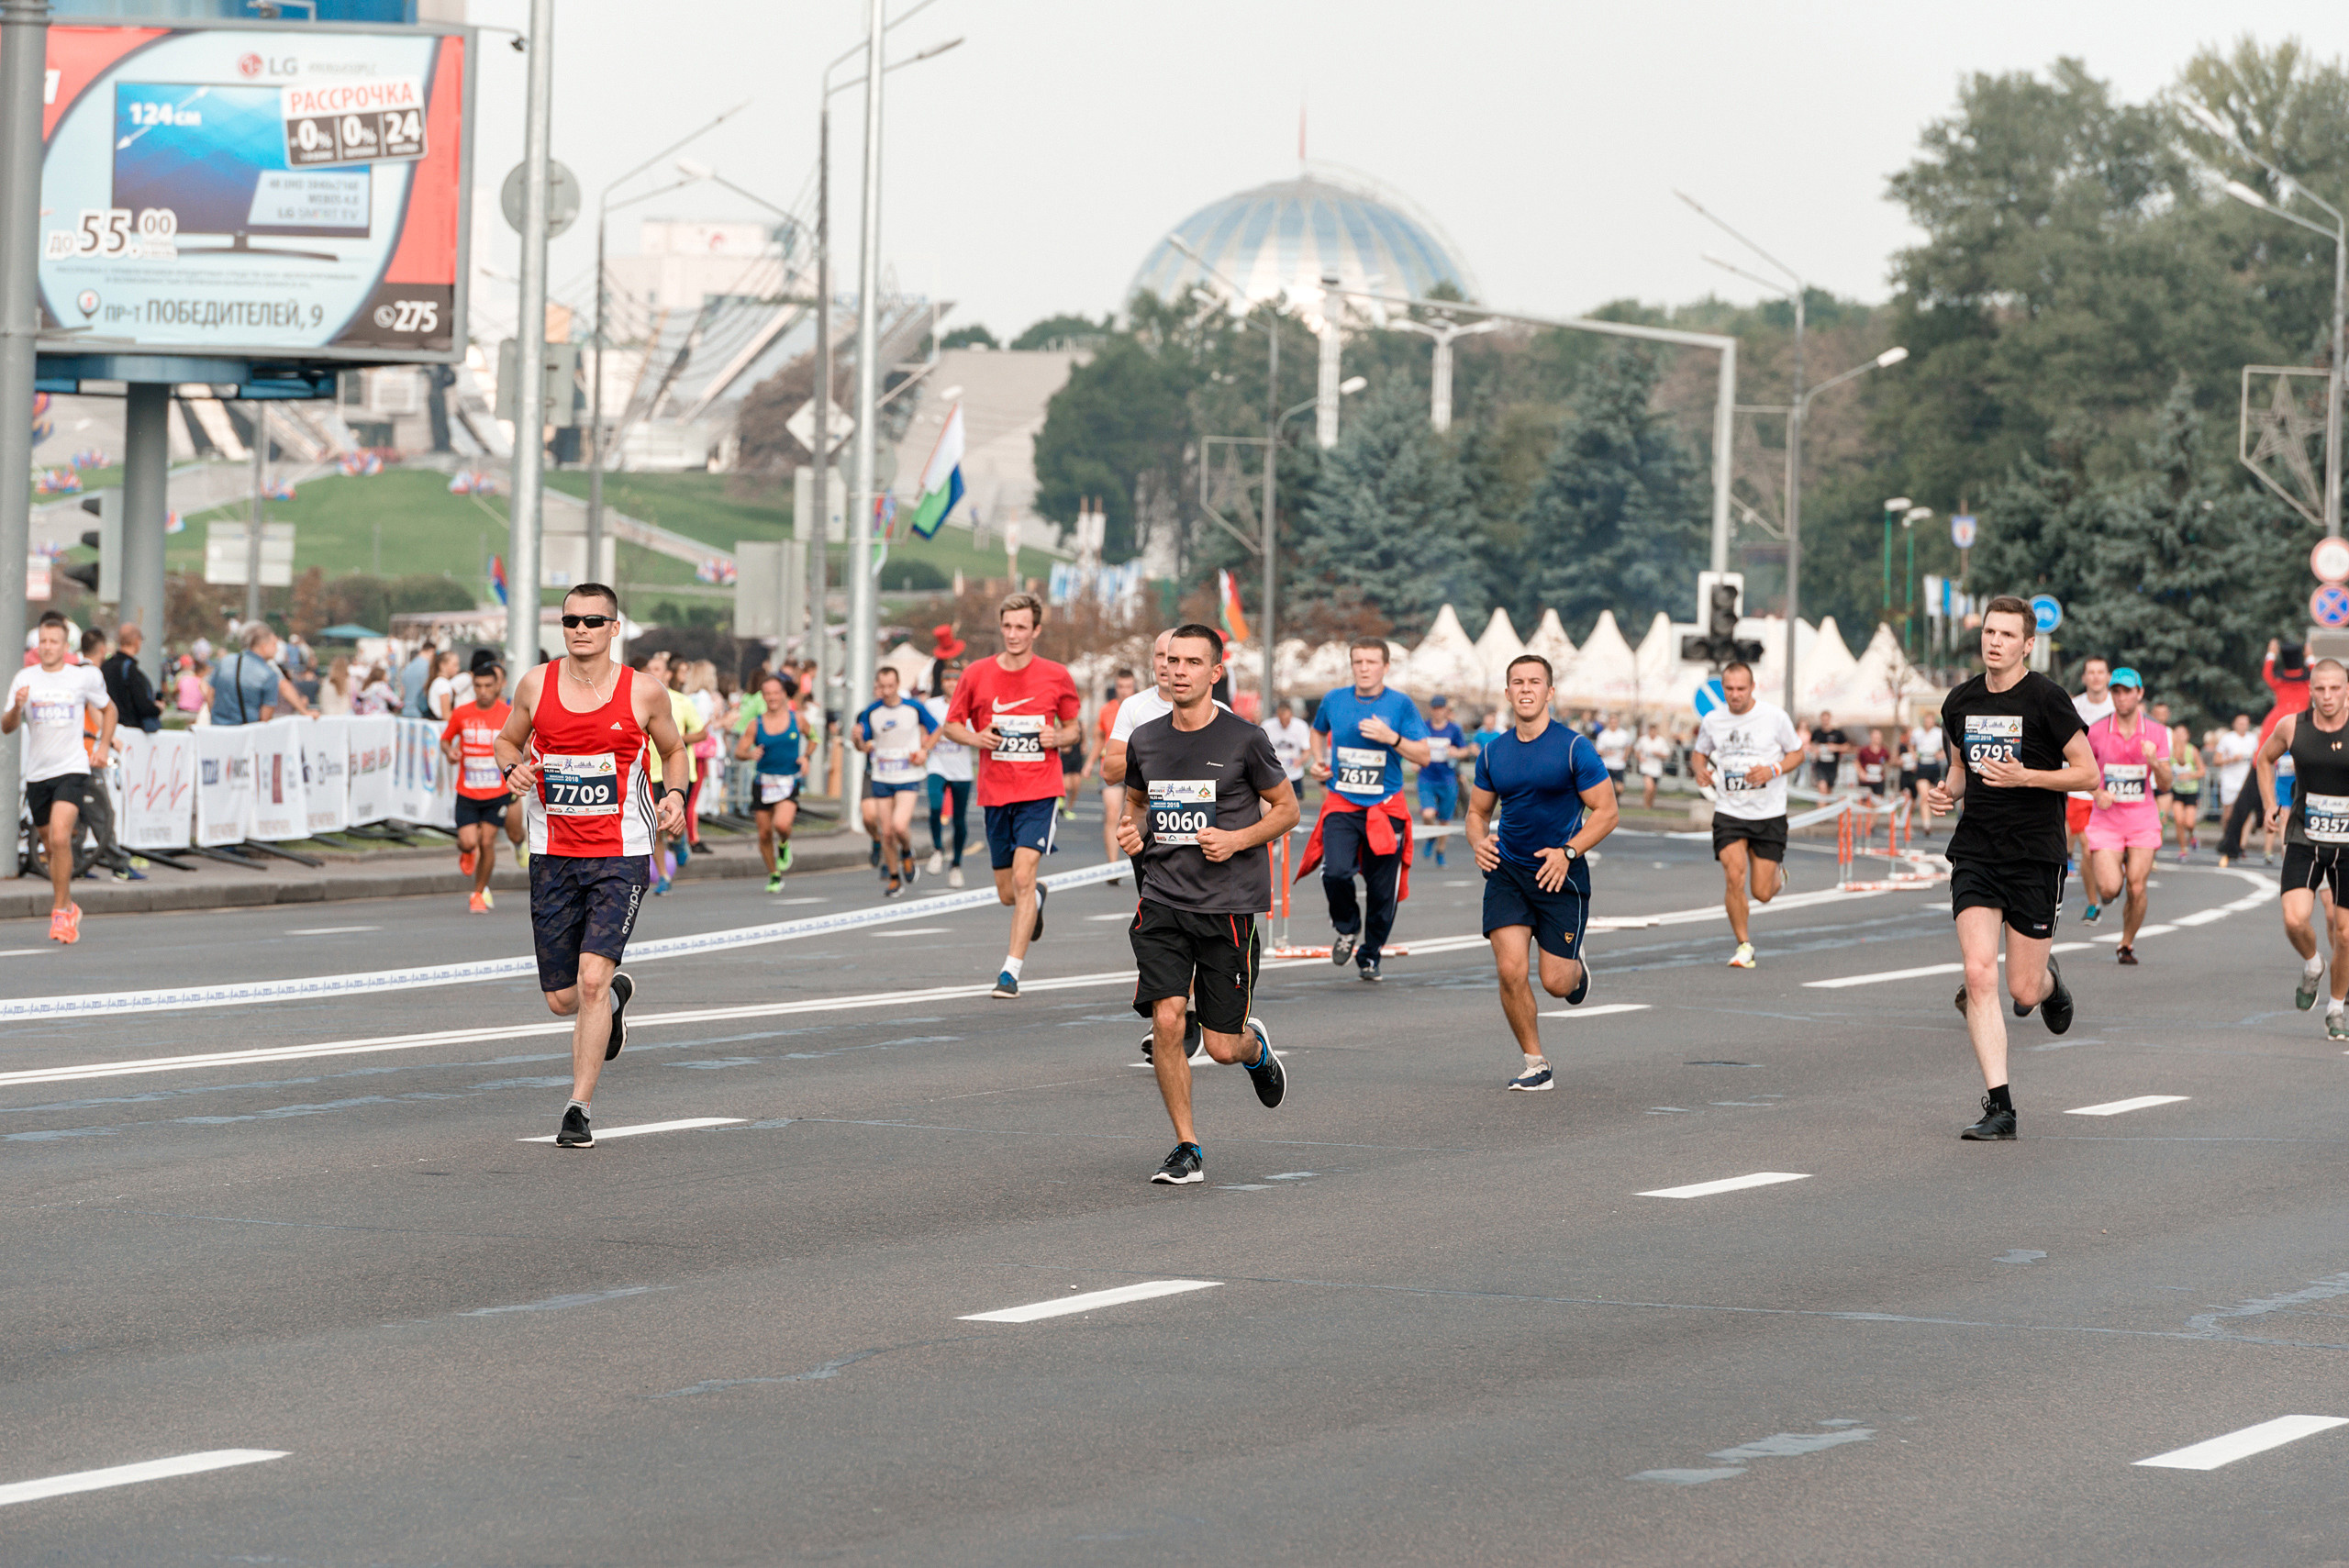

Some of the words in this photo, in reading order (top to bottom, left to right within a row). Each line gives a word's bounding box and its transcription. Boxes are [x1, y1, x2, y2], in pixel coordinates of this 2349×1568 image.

[269, 57, 298, 75] LG
[291, 83, 413, 113] РАССРОЧКА
[384, 110, 422, 144] 24
[148, 299, 306, 330] ПОБЕДИТЕЛЕЙ,
[309, 305, 324, 328] 9
[393, 300, 438, 332] 275
[998, 737, 1040, 752] 7926
[1970, 744, 2013, 762] 6793
[1341, 768, 1379, 784] 7617
[552, 784, 609, 804] 7709
[1156, 811, 1208, 831] 9060
[2310, 816, 2349, 832] 9357
[622, 884, 641, 934] adidas
